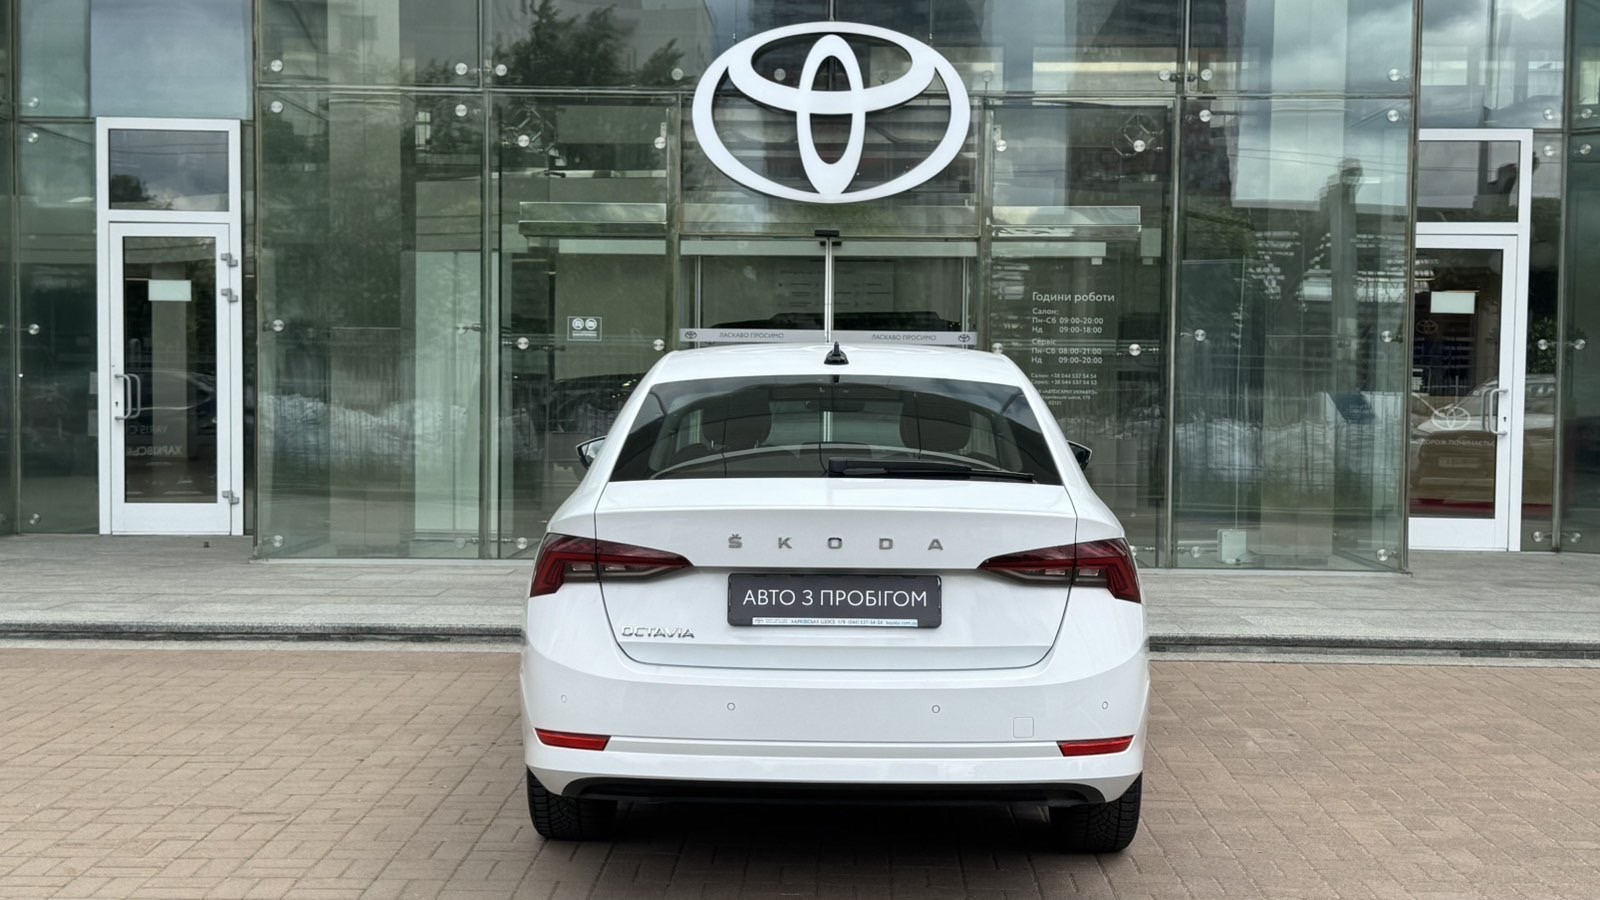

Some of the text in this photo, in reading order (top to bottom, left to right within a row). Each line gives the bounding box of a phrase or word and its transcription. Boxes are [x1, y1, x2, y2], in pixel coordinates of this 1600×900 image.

[1032, 292, 1115, 303] Години роботи
[1032, 307, 1059, 315] Салон:
[1059, 317, 1104, 325] 09:00-20:00
[719, 331, 785, 339] ЛАСКАВО ПРОСИМО
[872, 333, 902, 341] ЛАСКАВО
[1031, 347, 1056, 355] Пн-Сб
[728, 533, 944, 551] ŠKODA
[743, 589, 796, 606] АВТО
[820, 590, 927, 607] ПРОБІГОМ
[621, 626, 695, 639] OCTAVIA
